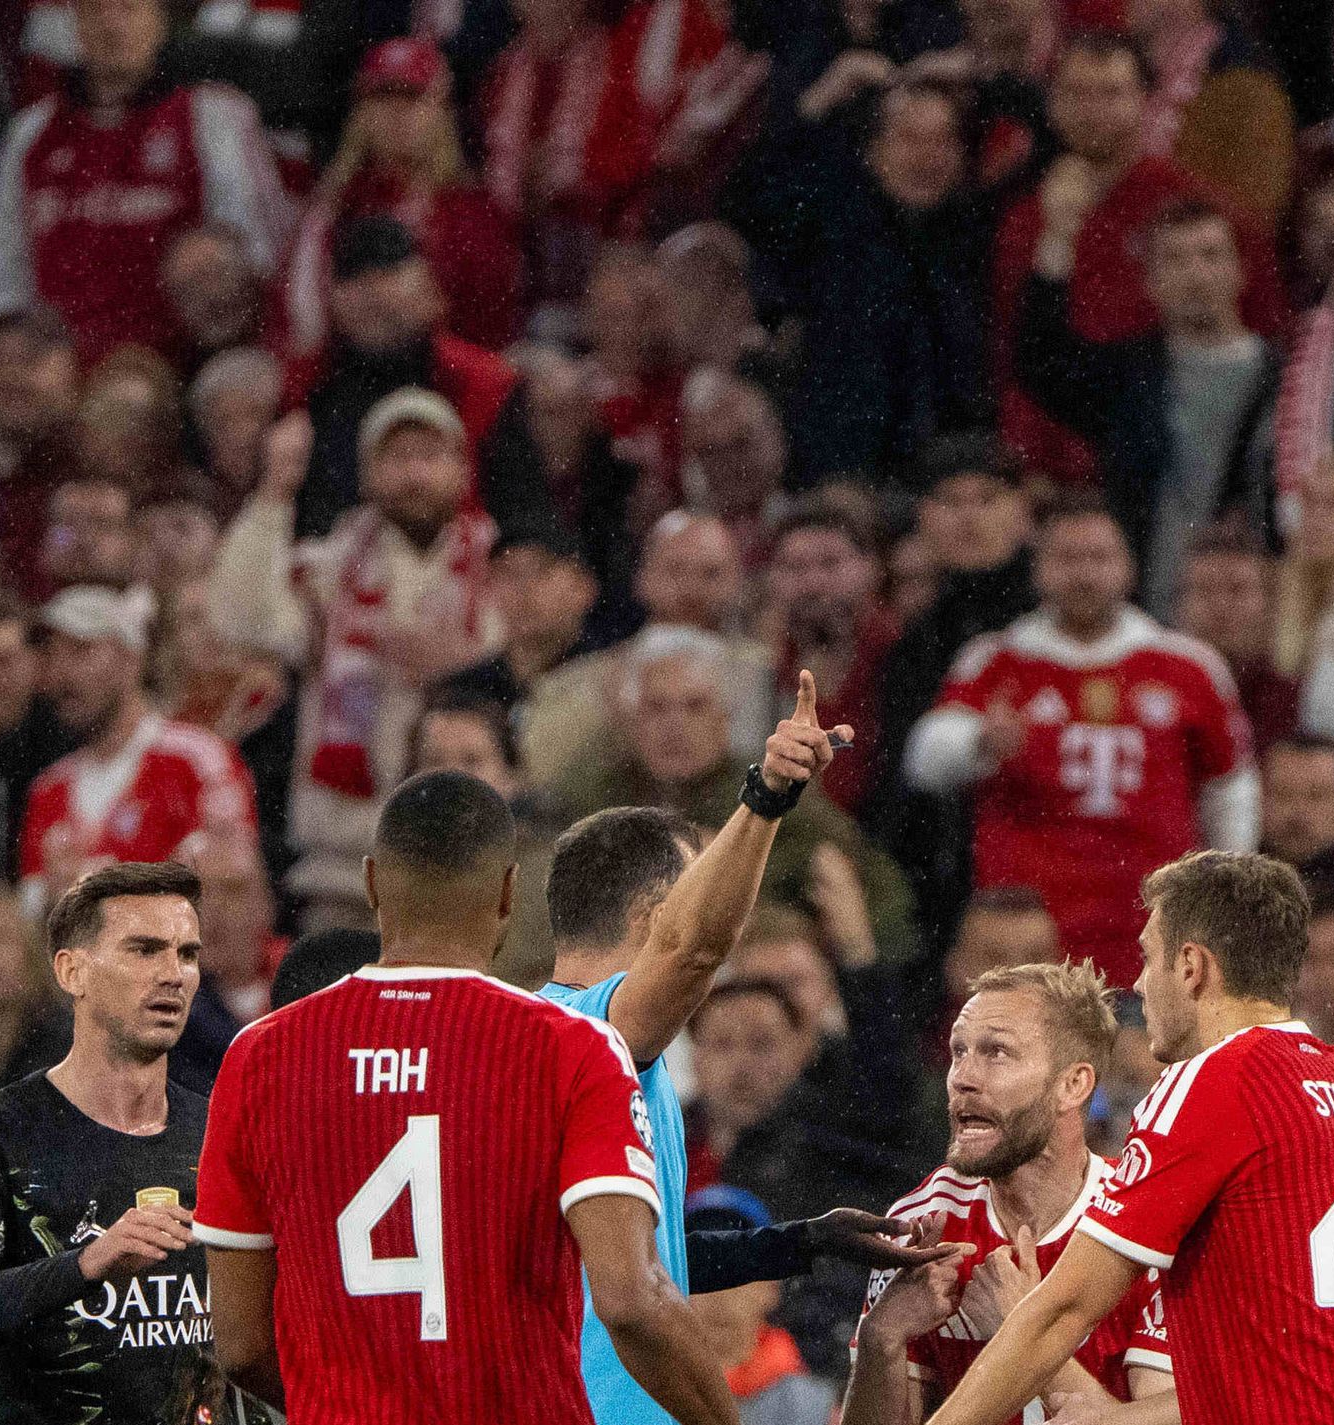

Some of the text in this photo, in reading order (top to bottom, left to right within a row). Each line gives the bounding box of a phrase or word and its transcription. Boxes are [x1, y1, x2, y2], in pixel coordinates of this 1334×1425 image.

[348, 1047, 429, 1095] TAH
[336, 1114, 447, 1342] 4
[73, 1273, 211, 1330] QATA
